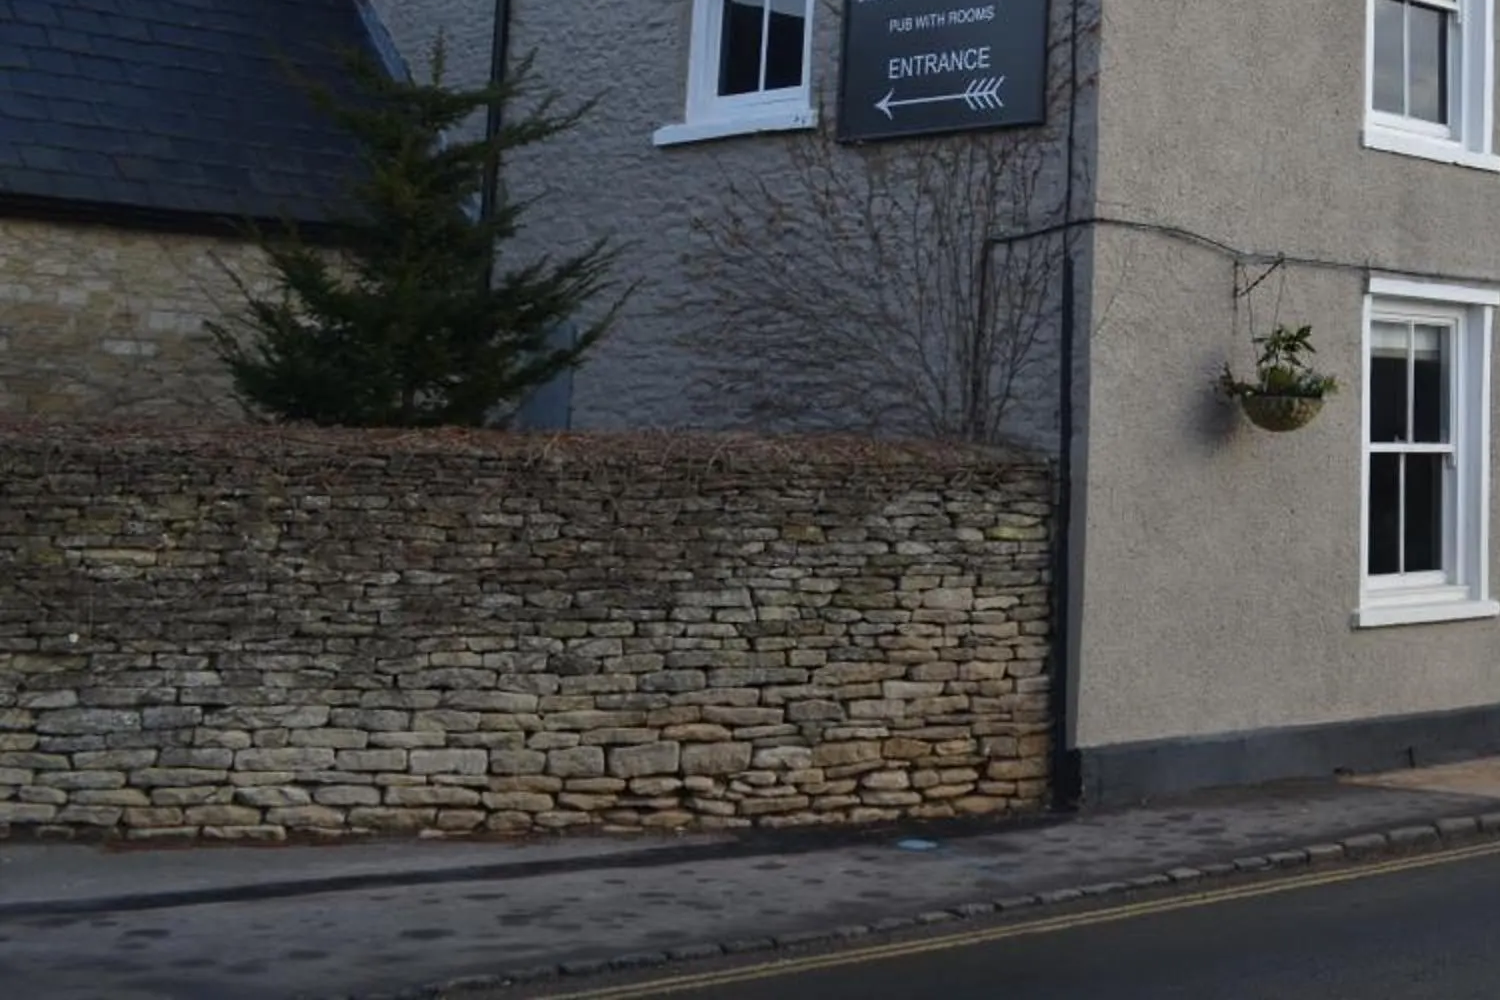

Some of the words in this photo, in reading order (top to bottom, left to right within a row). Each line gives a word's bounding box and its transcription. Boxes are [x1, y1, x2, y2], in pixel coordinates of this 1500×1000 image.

[889, 17, 913, 33] PUB
[915, 11, 945, 29] WITH
[947, 4, 995, 25] ROOMS
[888, 45, 991, 80] ENTRANCE
